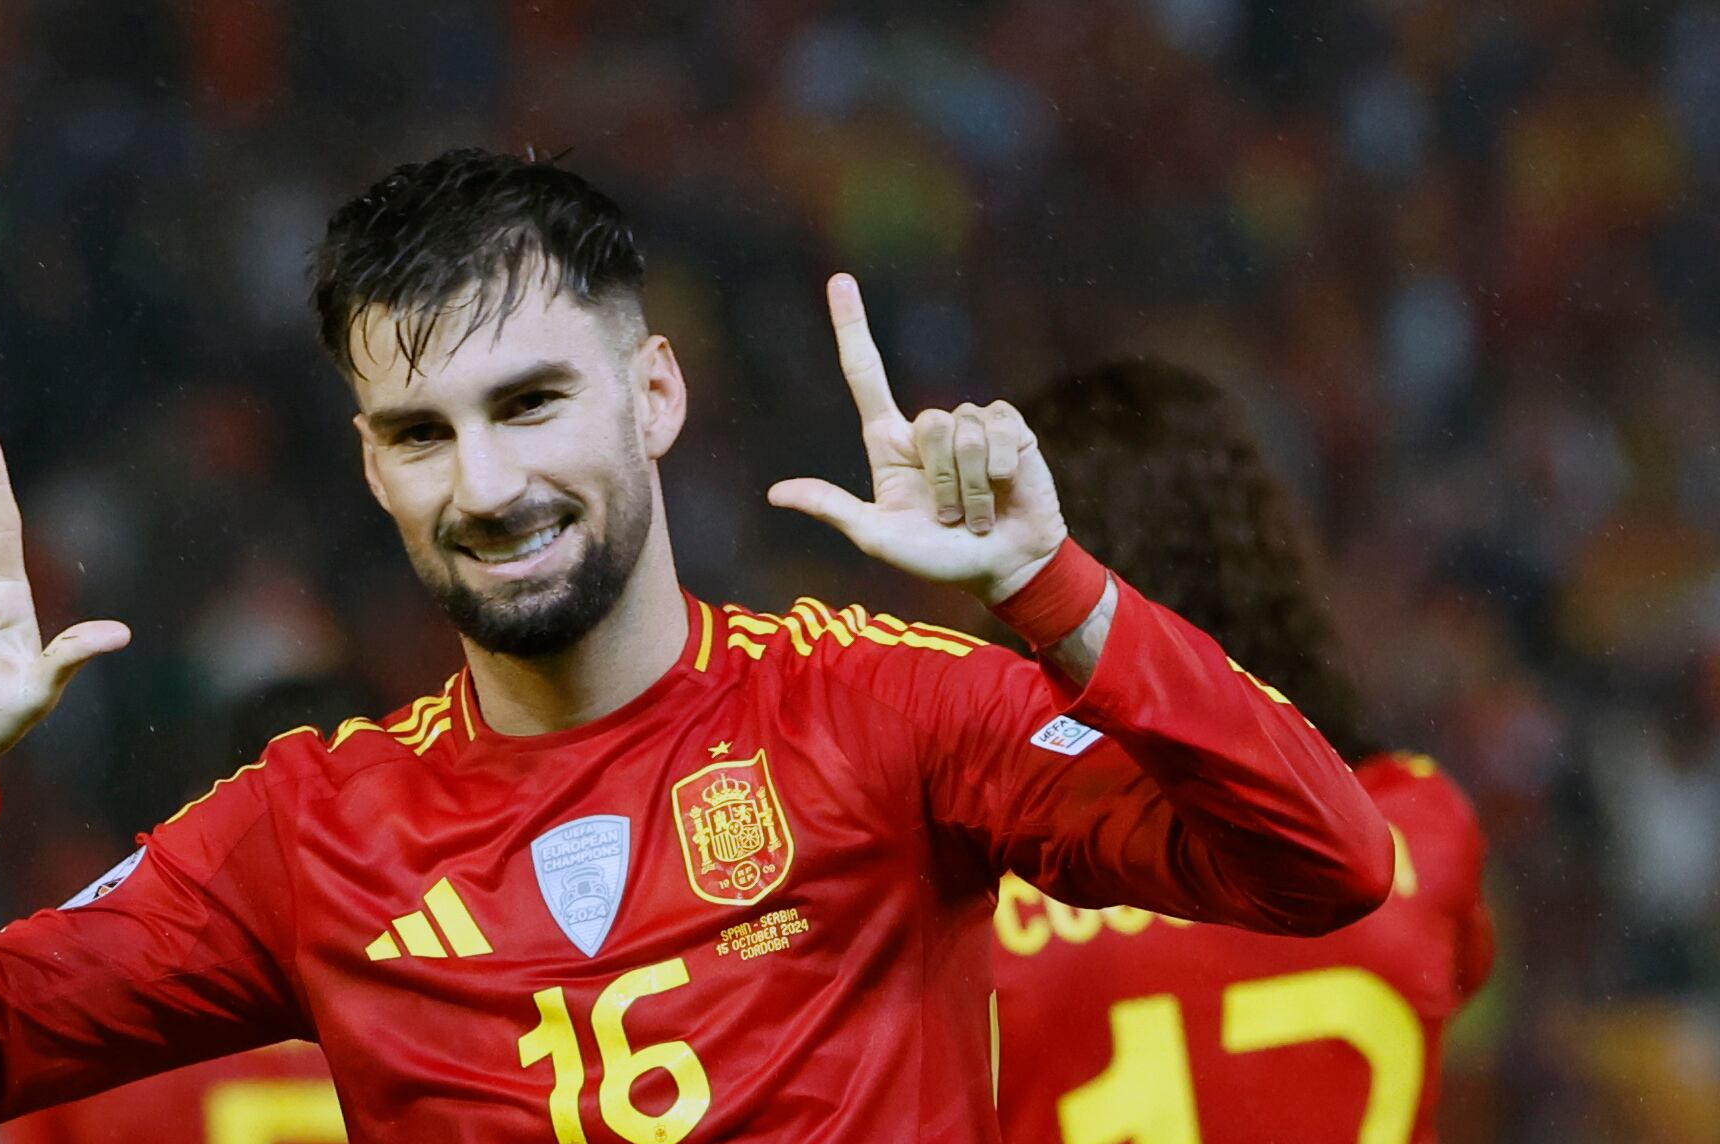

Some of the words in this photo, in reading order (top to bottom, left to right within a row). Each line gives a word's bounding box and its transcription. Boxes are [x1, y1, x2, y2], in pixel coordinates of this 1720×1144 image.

[542, 830, 618, 860] EUROPEAN
[563, 824, 595, 841] UEFA
[543, 845, 621, 873] CHAMPIONS
[567, 905, 608, 926] 2024
[720, 922, 752, 942] SPAIN
[760, 907, 799, 928] SERBIA
[716, 942, 729, 957] 15
[732, 925, 778, 951] OCTOBER
[780, 918, 810, 937] 2024
[740, 936, 791, 960] CORDOBA
